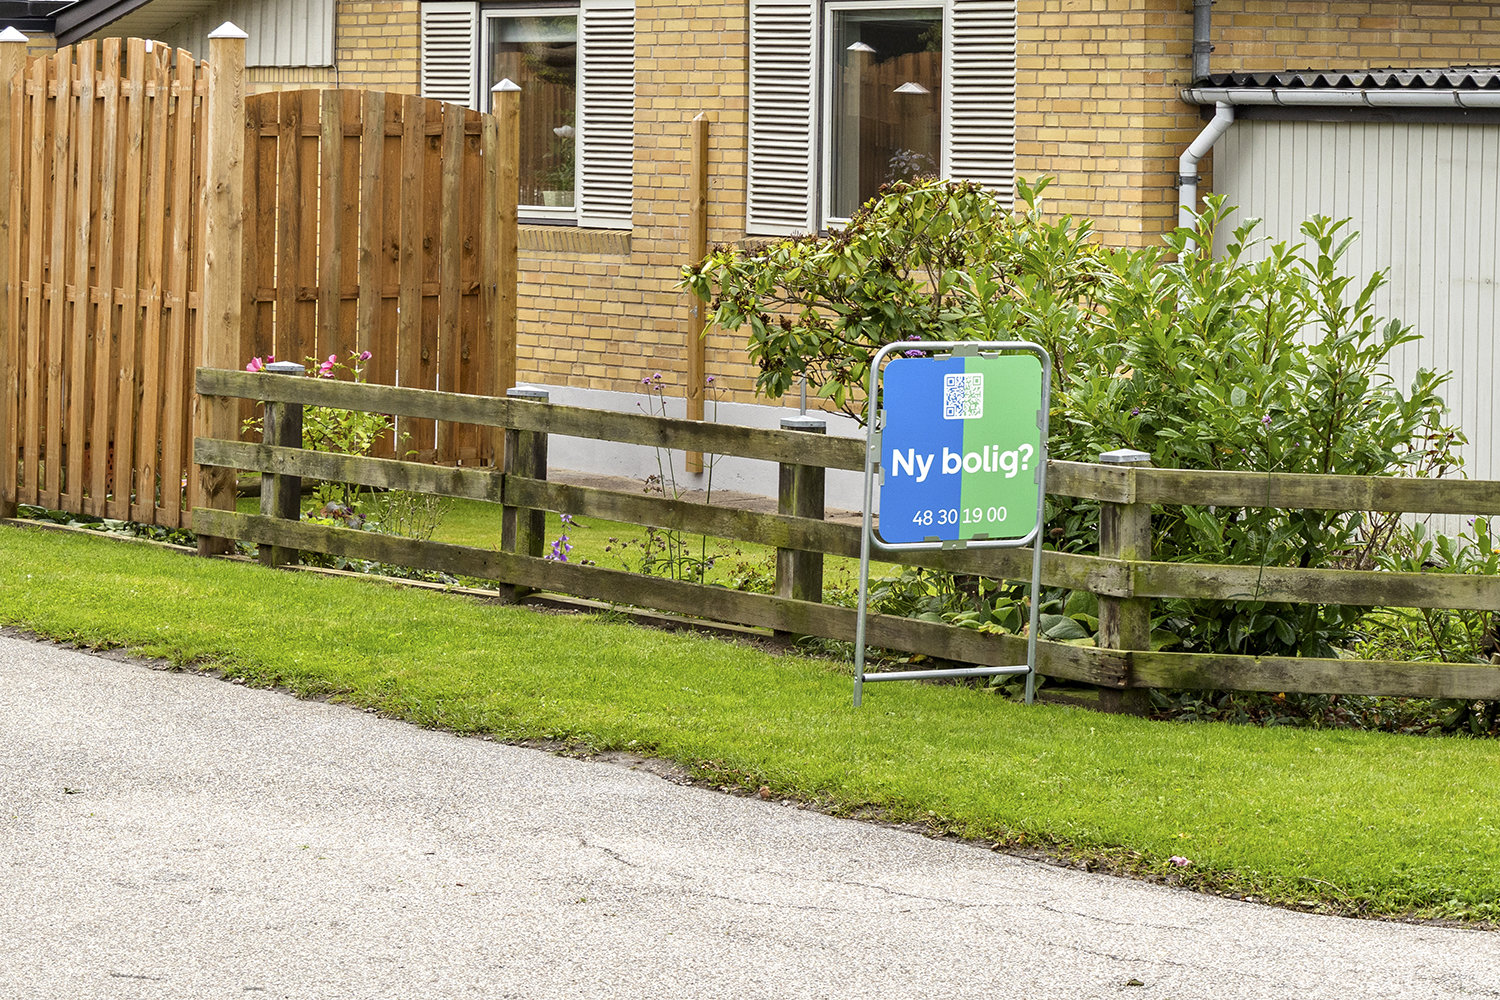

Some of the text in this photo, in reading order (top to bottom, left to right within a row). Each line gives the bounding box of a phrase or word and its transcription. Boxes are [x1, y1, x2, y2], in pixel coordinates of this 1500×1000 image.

[891, 443, 1034, 483] Ny bolig?
[912, 506, 1007, 526] 48 30 19 00
